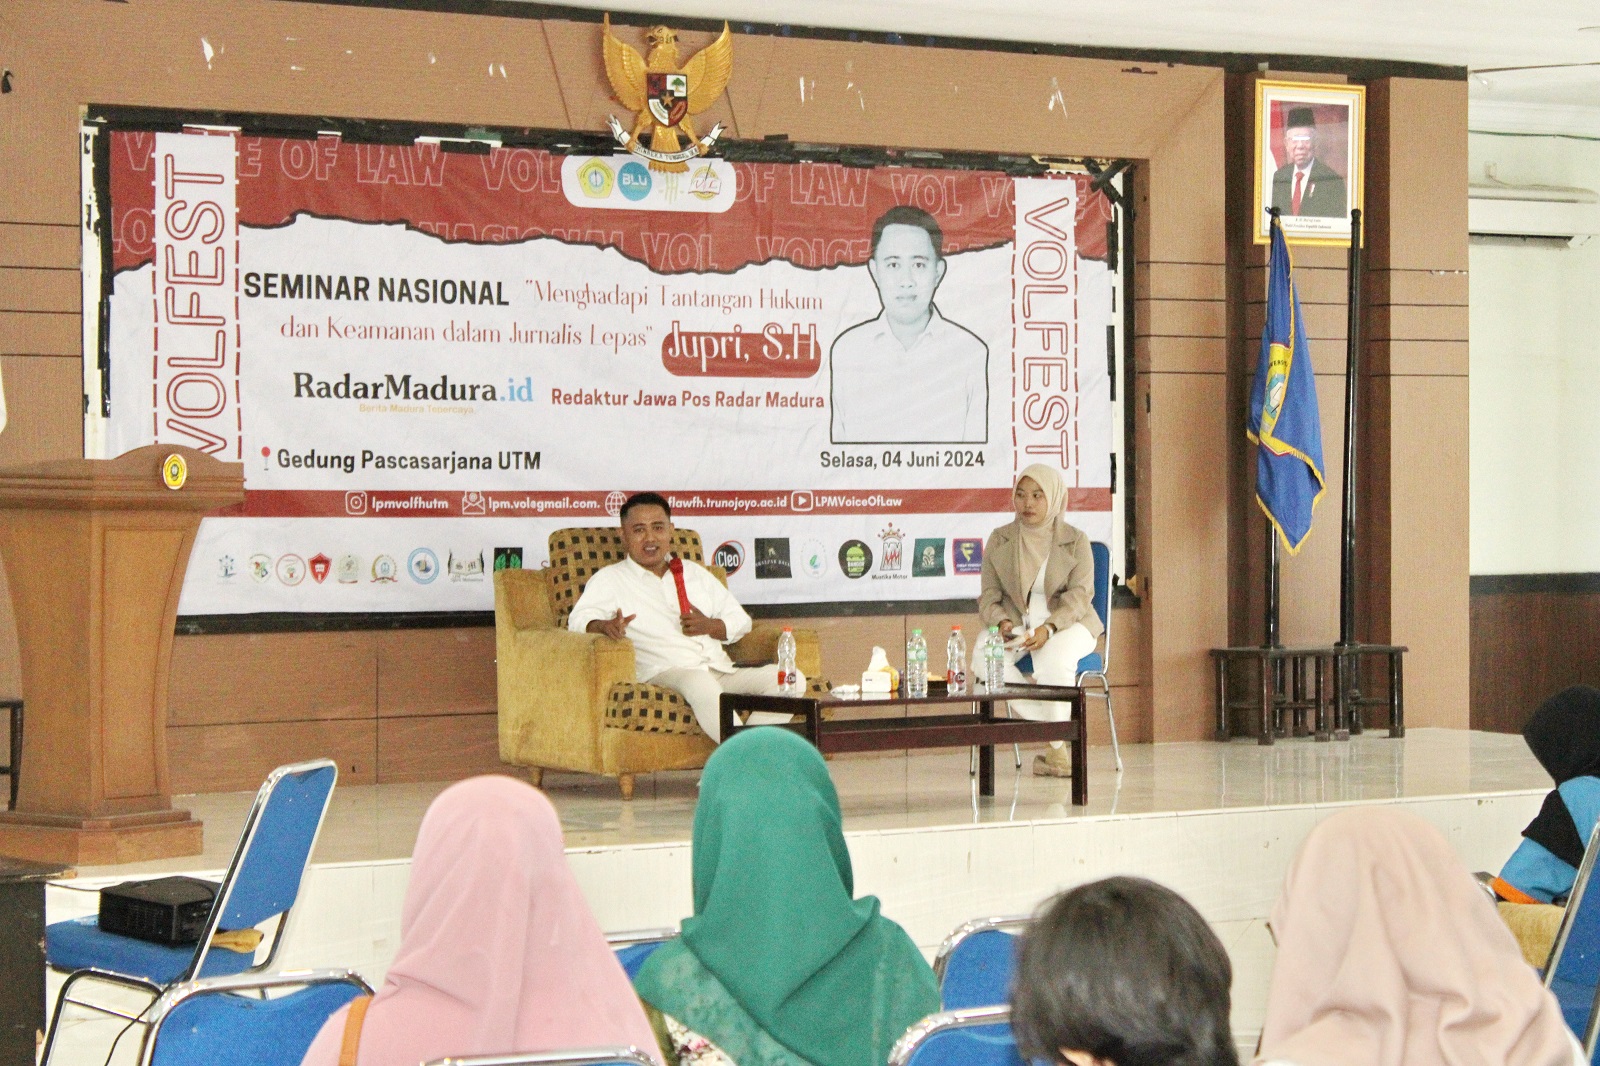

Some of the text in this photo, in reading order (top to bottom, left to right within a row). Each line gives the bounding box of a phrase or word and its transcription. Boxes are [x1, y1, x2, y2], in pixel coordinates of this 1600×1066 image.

[622, 172, 648, 186] BLU
[891, 173, 962, 217] VOL
[165, 153, 228, 455] VOLFEST
[244, 272, 370, 301] SEMINAR
[378, 276, 510, 306] NASIONAL
[657, 284, 752, 315] Tantangan
[760, 288, 823, 311] Hukum
[280, 315, 319, 338] dan
[328, 316, 435, 341] Keamanan
[443, 320, 501, 343] dalam
[509, 321, 582, 345] Jurnalis
[1022, 197, 1070, 470] VOLFEST
[668, 320, 817, 373] Jupri, S.H
[293, 372, 533, 403] RadarMadura.id
[551, 388, 825, 408] Redaktur Jawa Pos Radar Madura
[277, 449, 541, 474] Gedung Pascasarjana UTM
[820, 451, 985, 470] Selasa, 04 Juni 2024
[372, 496, 449, 512] lpmvolfhutm
[815, 495, 903, 508] LPMVoiceOfLaw
[717, 551, 739, 567] Cleo
